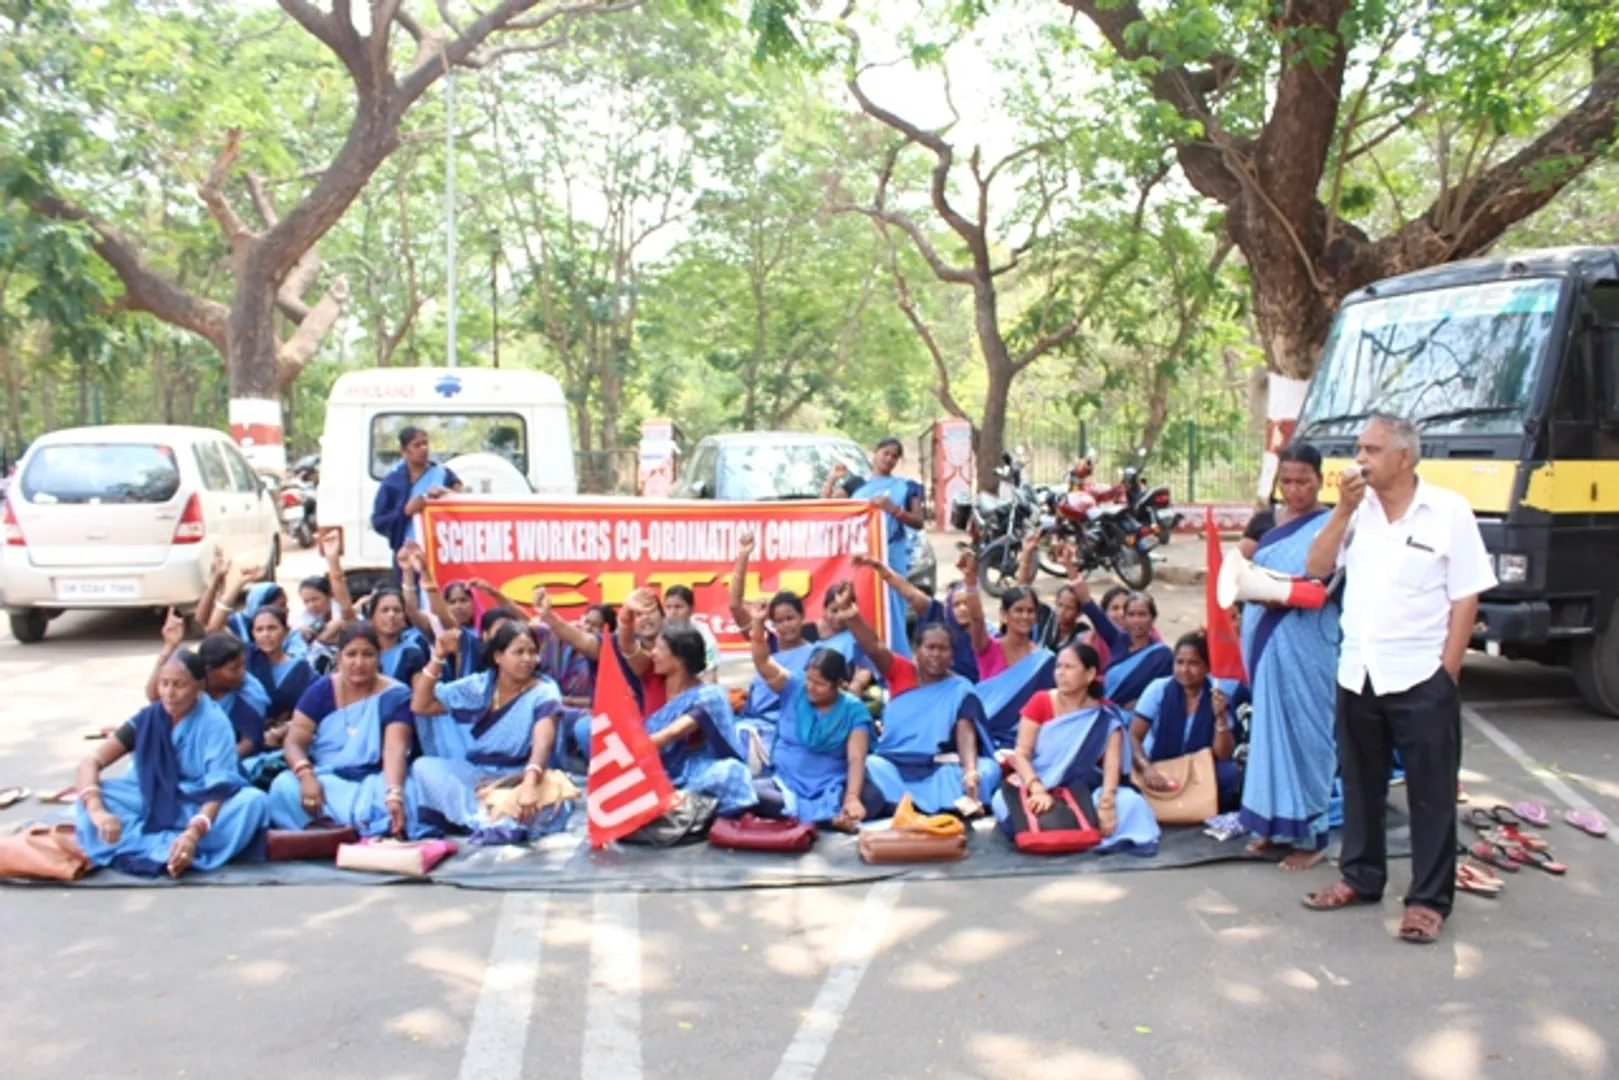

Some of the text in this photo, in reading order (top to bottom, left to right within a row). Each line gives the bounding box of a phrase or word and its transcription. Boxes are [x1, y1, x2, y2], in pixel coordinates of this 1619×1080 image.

[435, 519, 514, 564] SCHEME
[516, 519, 612, 562] WORKERS
[615, 519, 762, 562] CO-ORDINATION
[502, 570, 812, 607] CITU
